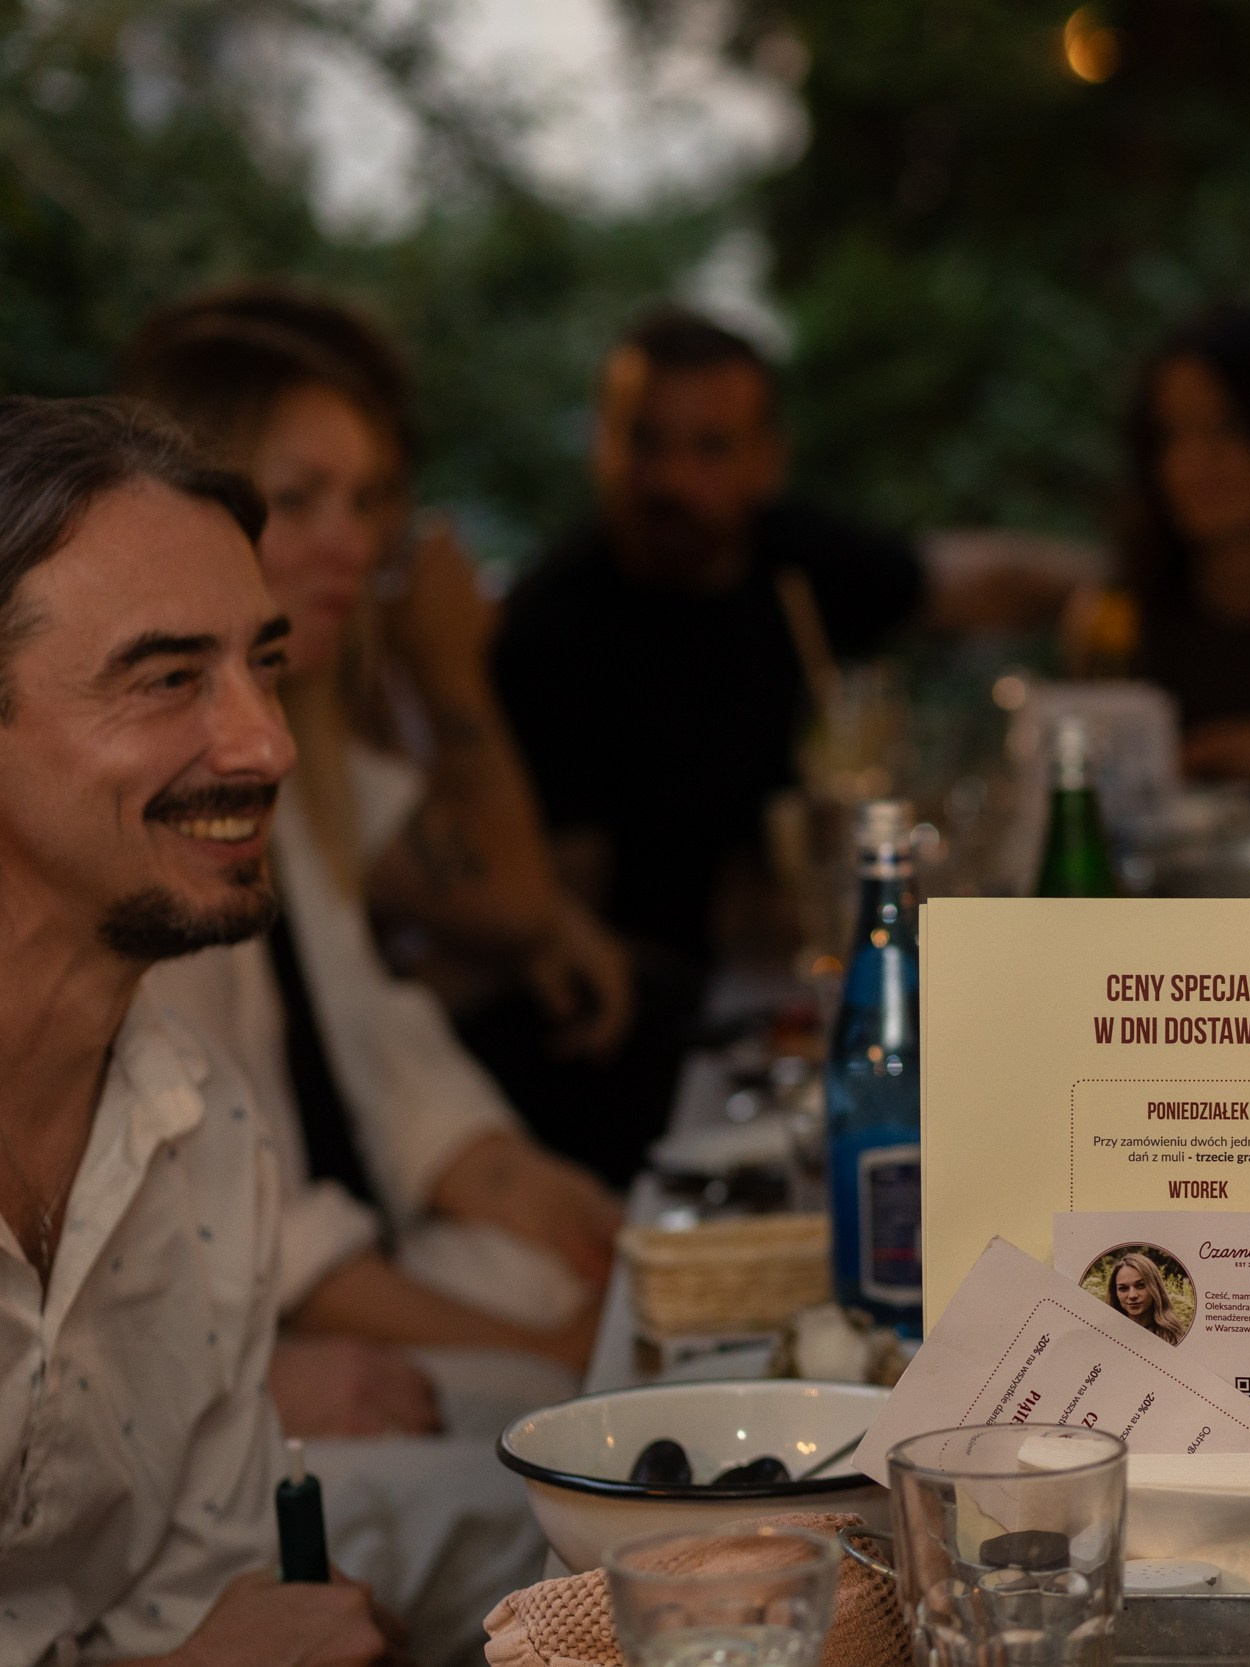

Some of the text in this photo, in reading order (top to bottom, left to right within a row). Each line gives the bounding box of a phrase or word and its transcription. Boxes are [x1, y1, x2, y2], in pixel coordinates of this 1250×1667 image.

[1106, 974, 1165, 1002] CENY
[1093, 1017, 1115, 1044] W
[1120, 1017, 1158, 1044] DNI
[1147, 1101, 1250, 1121] PONIEDZIAŁEK
[1093, 1135, 1118, 1149] Przy
[1120, 1135, 1188, 1148] zamówieniu
[1190, 1135, 1228, 1148] dwóch
[1128, 1151, 1150, 1163] dań
[1152, 1154, 1158, 1163] z
[1161, 1151, 1186, 1163] muli
[1195, 1151, 1235, 1163] trzecie
[1168, 1180, 1229, 1200] WTOREK
[1204, 1291, 1231, 1301] Cześć,
[1204, 1302, 1250, 1312] Oleksandra
[985, 1332, 1050, 1427] -20% na wszystkie dania
[1084, 1362, 1103, 1386] -30%
[1077, 1384, 1088, 1396] na
[1137, 1391, 1155, 1415] -20%
[1130, 1413, 1141, 1425] na
[1187, 1426, 1211, 1454] Ostryg
